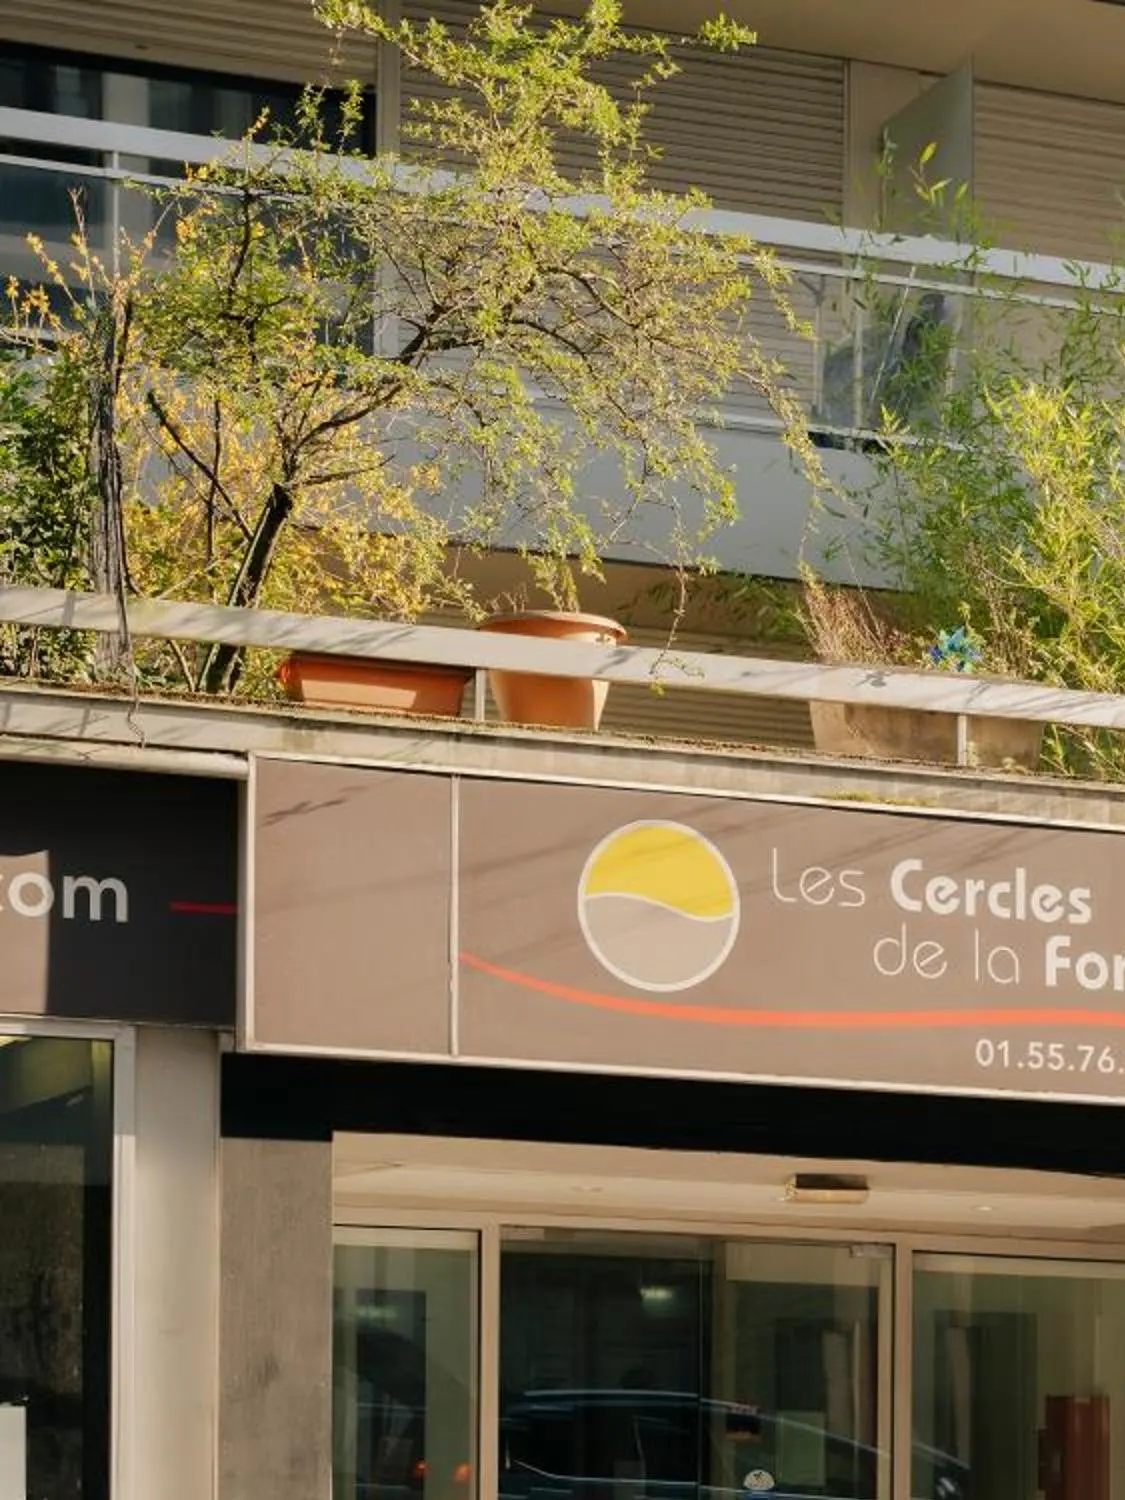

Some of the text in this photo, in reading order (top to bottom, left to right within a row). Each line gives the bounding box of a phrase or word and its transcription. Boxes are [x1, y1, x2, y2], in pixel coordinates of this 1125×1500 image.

[0, 872, 129, 923] om
[772, 847, 1092, 925] Les Cercles
[873, 922, 948, 979] de
[974, 928, 1019, 984] la
